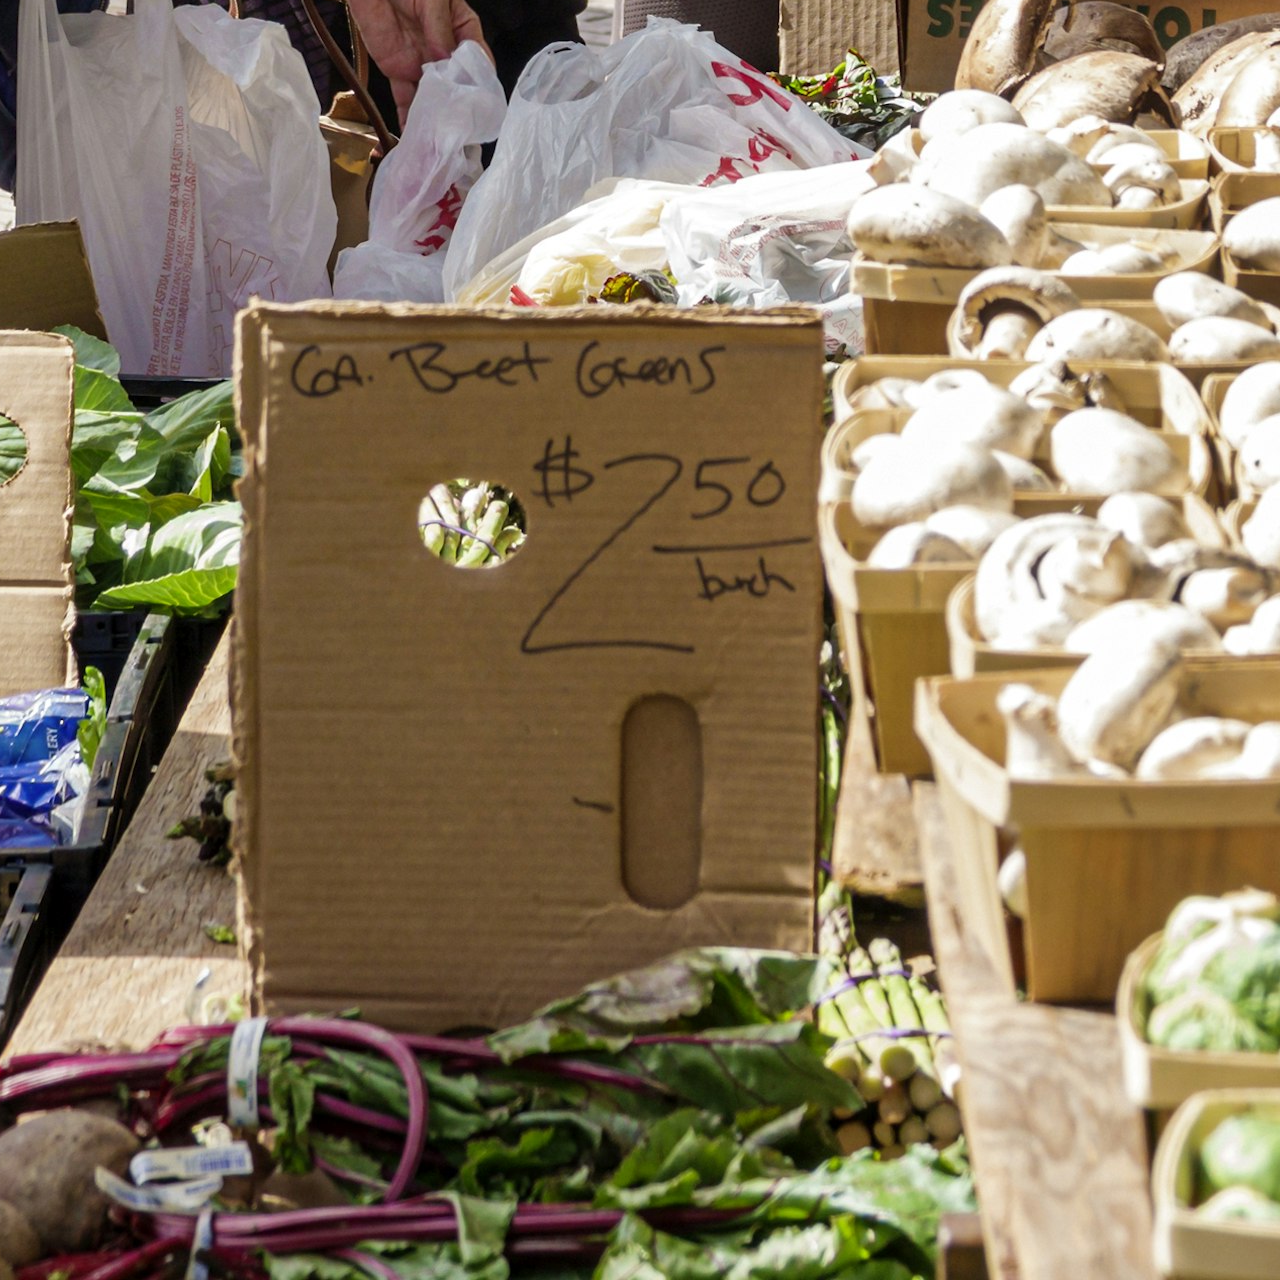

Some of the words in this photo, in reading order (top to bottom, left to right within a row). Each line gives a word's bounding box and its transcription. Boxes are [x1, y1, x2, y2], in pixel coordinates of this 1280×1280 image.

[175, 106, 185, 132] LEJOS
[170, 172, 181, 184] DE
[168, 208, 178, 228] ESTA
[162, 308, 176, 335] BOLSA
[160, 335, 172, 355] ESTA
[389, 340, 553, 394] Beet
[575, 340, 727, 398] Greens
